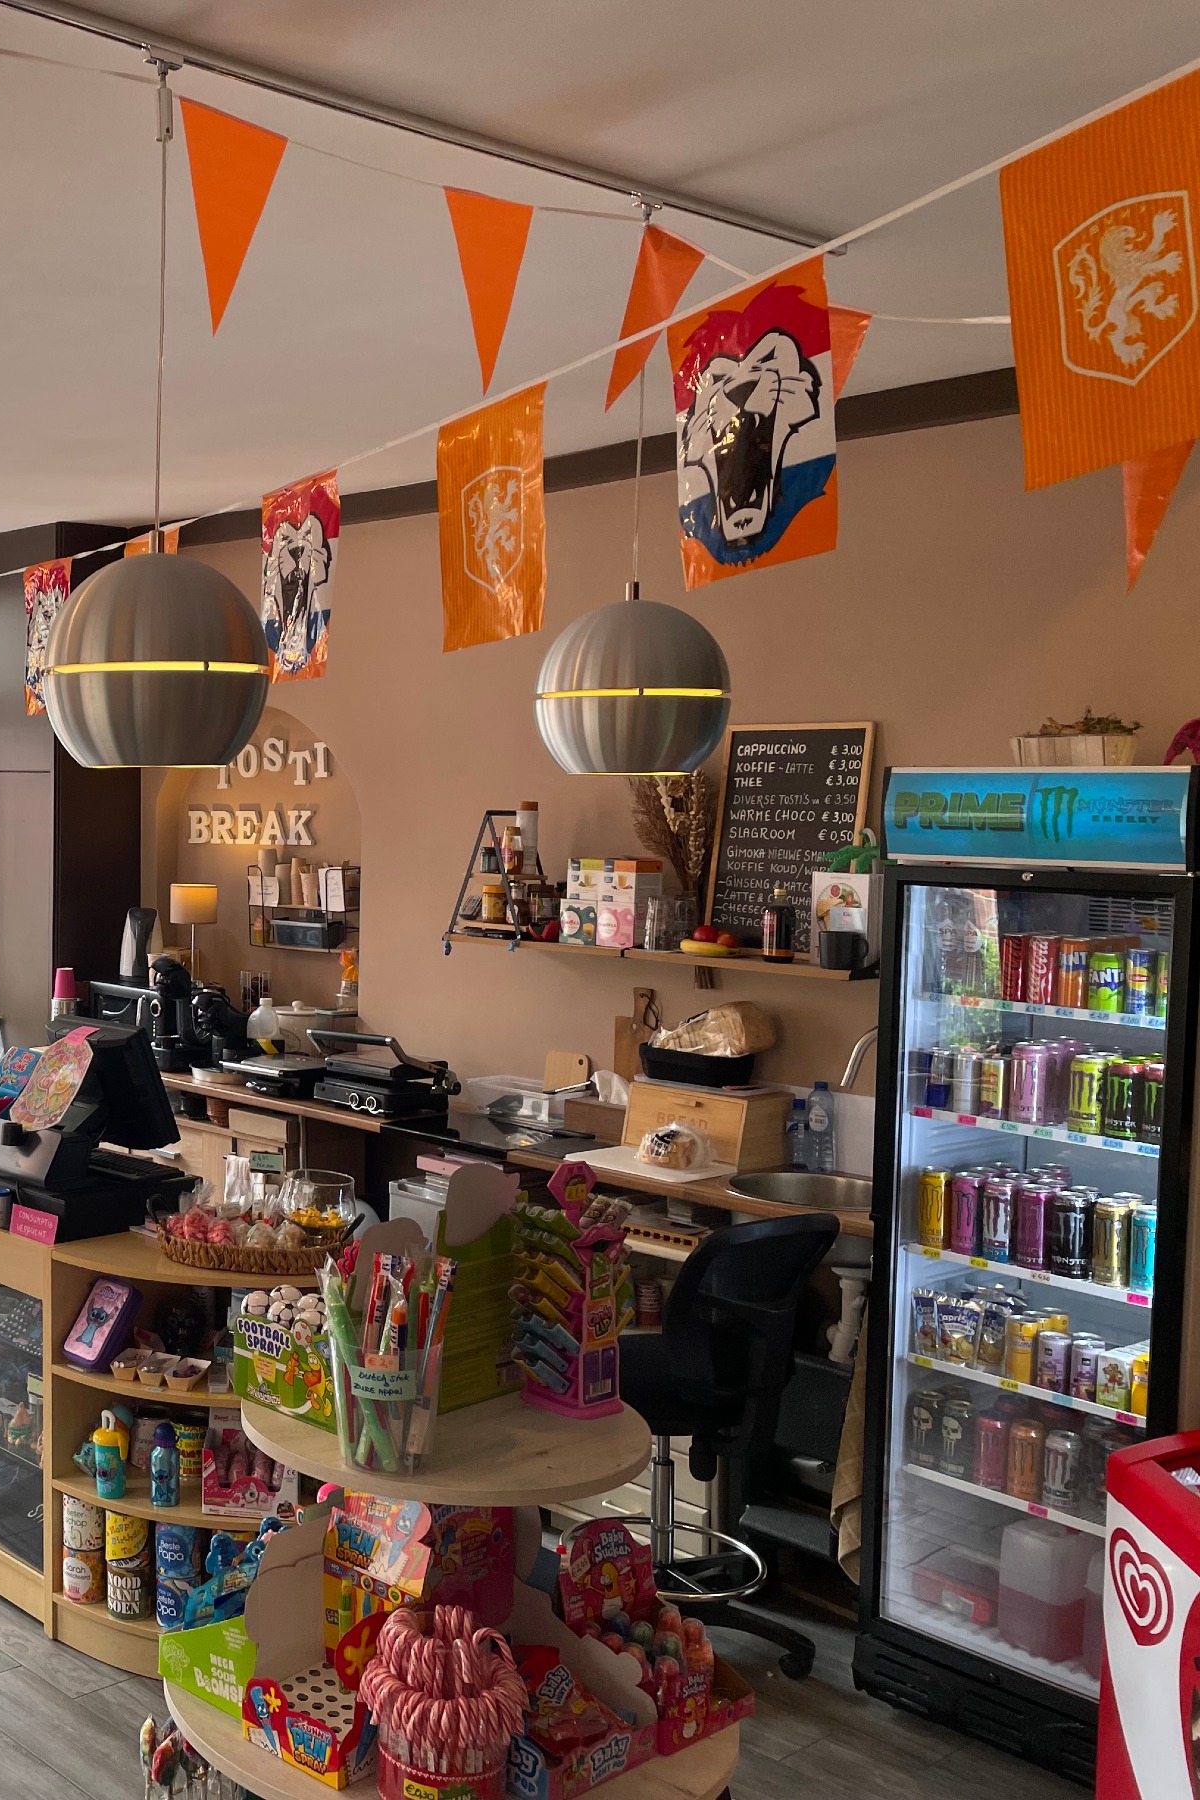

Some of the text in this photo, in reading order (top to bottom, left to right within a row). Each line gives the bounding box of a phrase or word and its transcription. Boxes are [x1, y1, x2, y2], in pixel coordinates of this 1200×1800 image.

[737, 742, 807, 757] CAPPUCCINO
[217, 738, 331, 789] TOSTI
[735, 761, 776, 773] KOFFIE
[785, 763, 815, 774] LATTE
[734, 777, 763, 787] THEE
[733, 795, 776, 808] DIVERSE
[730, 810, 771, 821] WARME
[775, 809, 816, 821] CHOCO
[894, 791, 1026, 831] PRIME
[188, 810, 315, 845] BREAK
[729, 826, 796, 840] SLAGROOM
[767, 847, 802, 861] NIEUWE
[726, 861, 764, 872] KOFFIE
[237, 1318, 292, 1351] FOOTBALL
[246, 1334, 283, 1359] SPRAY
[160, 1539, 181, 1551] Beste
[336, 1523, 377, 1555] PEN
[599, 1528, 626, 1545] Baby
[158, 1547, 185, 1563] Papa
[336, 1546, 372, 1569] SPRAY
[65, 1562, 87, 1574] Sarah
[107, 1571, 141, 1589] NOOD
[107, 1586, 142, 1602] RANT
[107, 1600, 141, 1616] SOEN
[156, 1601, 177, 1617] Opa
[209, 1653, 235, 1672] MEGA
[211, 1667, 237, 1685] SOUR
[538, 1664, 570, 1699] Baby
[290, 1728, 329, 1762] PEN
[590, 1734, 630, 1772] Baby
[294, 1750, 328, 1776] SPRAY
